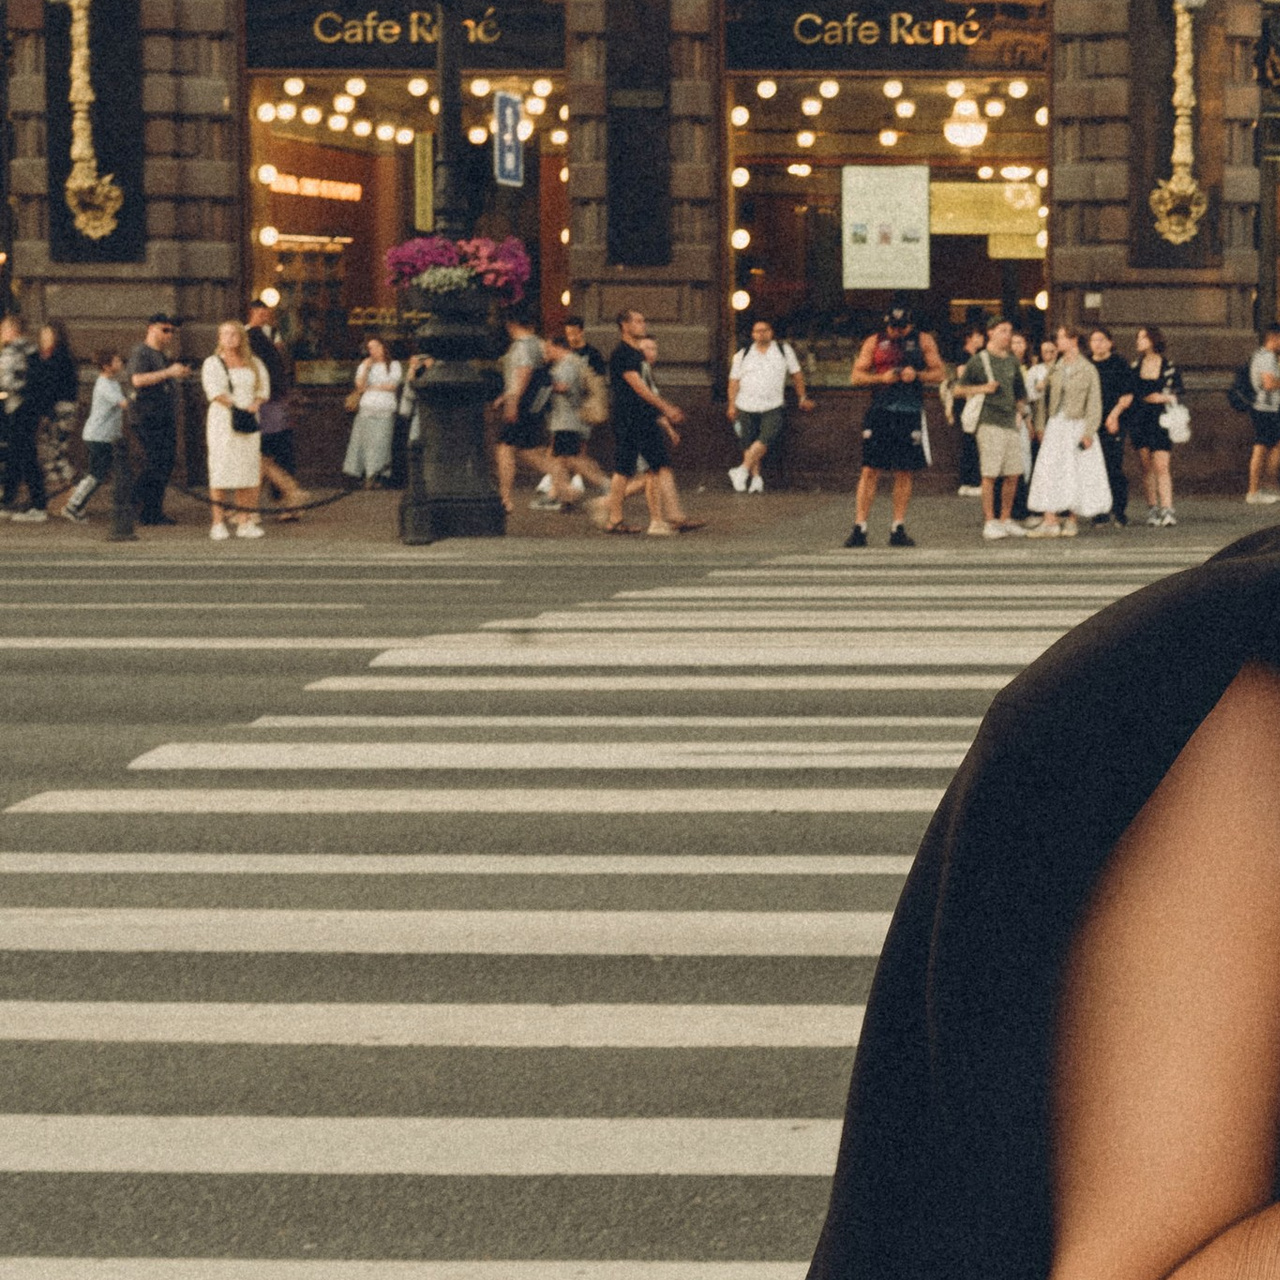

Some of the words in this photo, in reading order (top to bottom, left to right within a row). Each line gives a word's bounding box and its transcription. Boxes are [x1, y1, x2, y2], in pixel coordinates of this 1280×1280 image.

[313, 10, 401, 44] Cafe
[793, 11, 880, 45] Cafe
[890, 7, 983, 46] René
